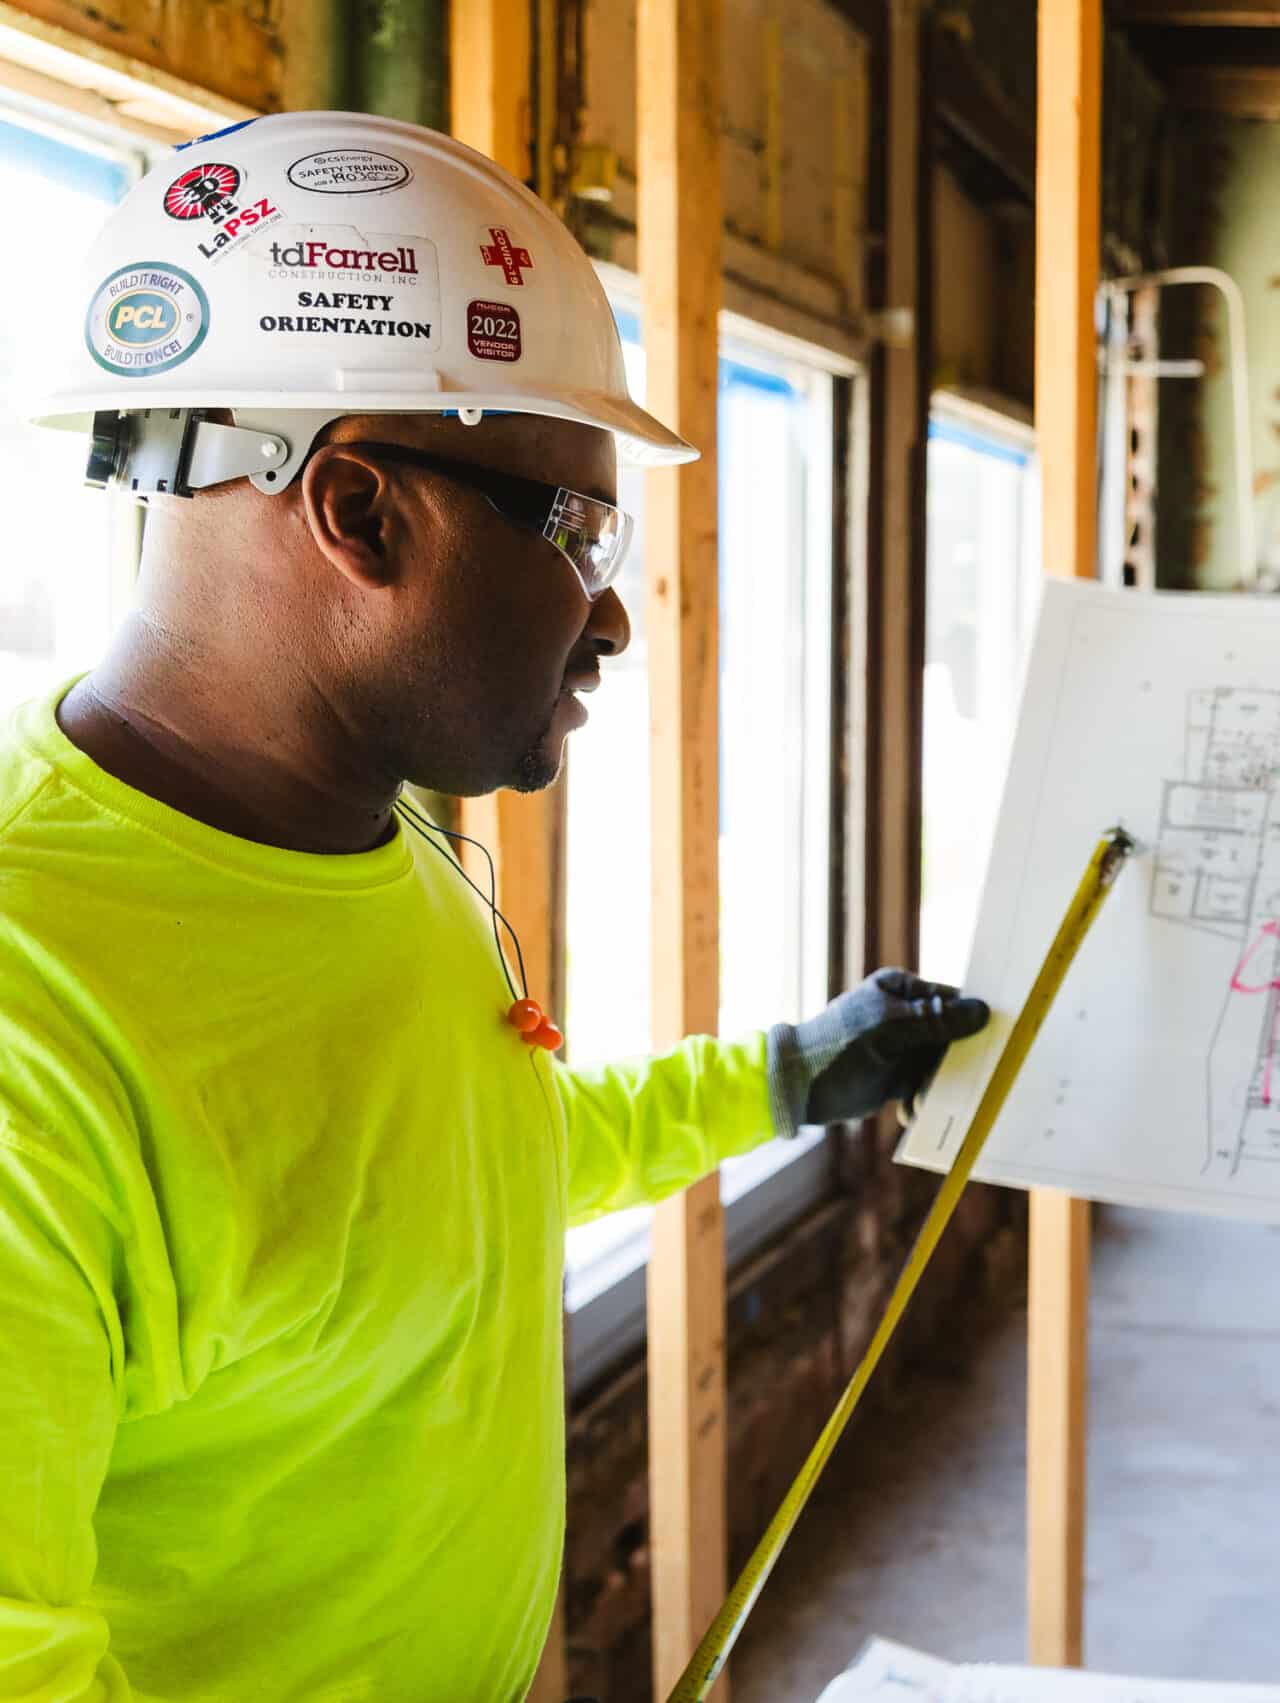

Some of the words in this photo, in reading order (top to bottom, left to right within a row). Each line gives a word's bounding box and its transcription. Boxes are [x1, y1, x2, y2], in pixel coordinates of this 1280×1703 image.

[299, 166, 343, 179] SAFETY
[345, 164, 399, 172] TRAINED
[197, 198, 277, 259] LaPSZ
[269, 241, 418, 274] tdFarrell
[494, 230, 519, 284] COVID-19
[110, 275, 138, 297] BUILD
[150, 274, 184, 295] RIGHT
[268, 270, 382, 283] CONSTRUCTION
[391, 275, 417, 286] INC
[298, 291, 394, 311] SAFETY
[115, 306, 167, 329] PCL
[260, 316, 432, 338] ORIENTATION
[471, 315, 518, 339] 2022
[104, 344, 133, 365] BUILD
[477, 347, 514, 358] VISITOR
